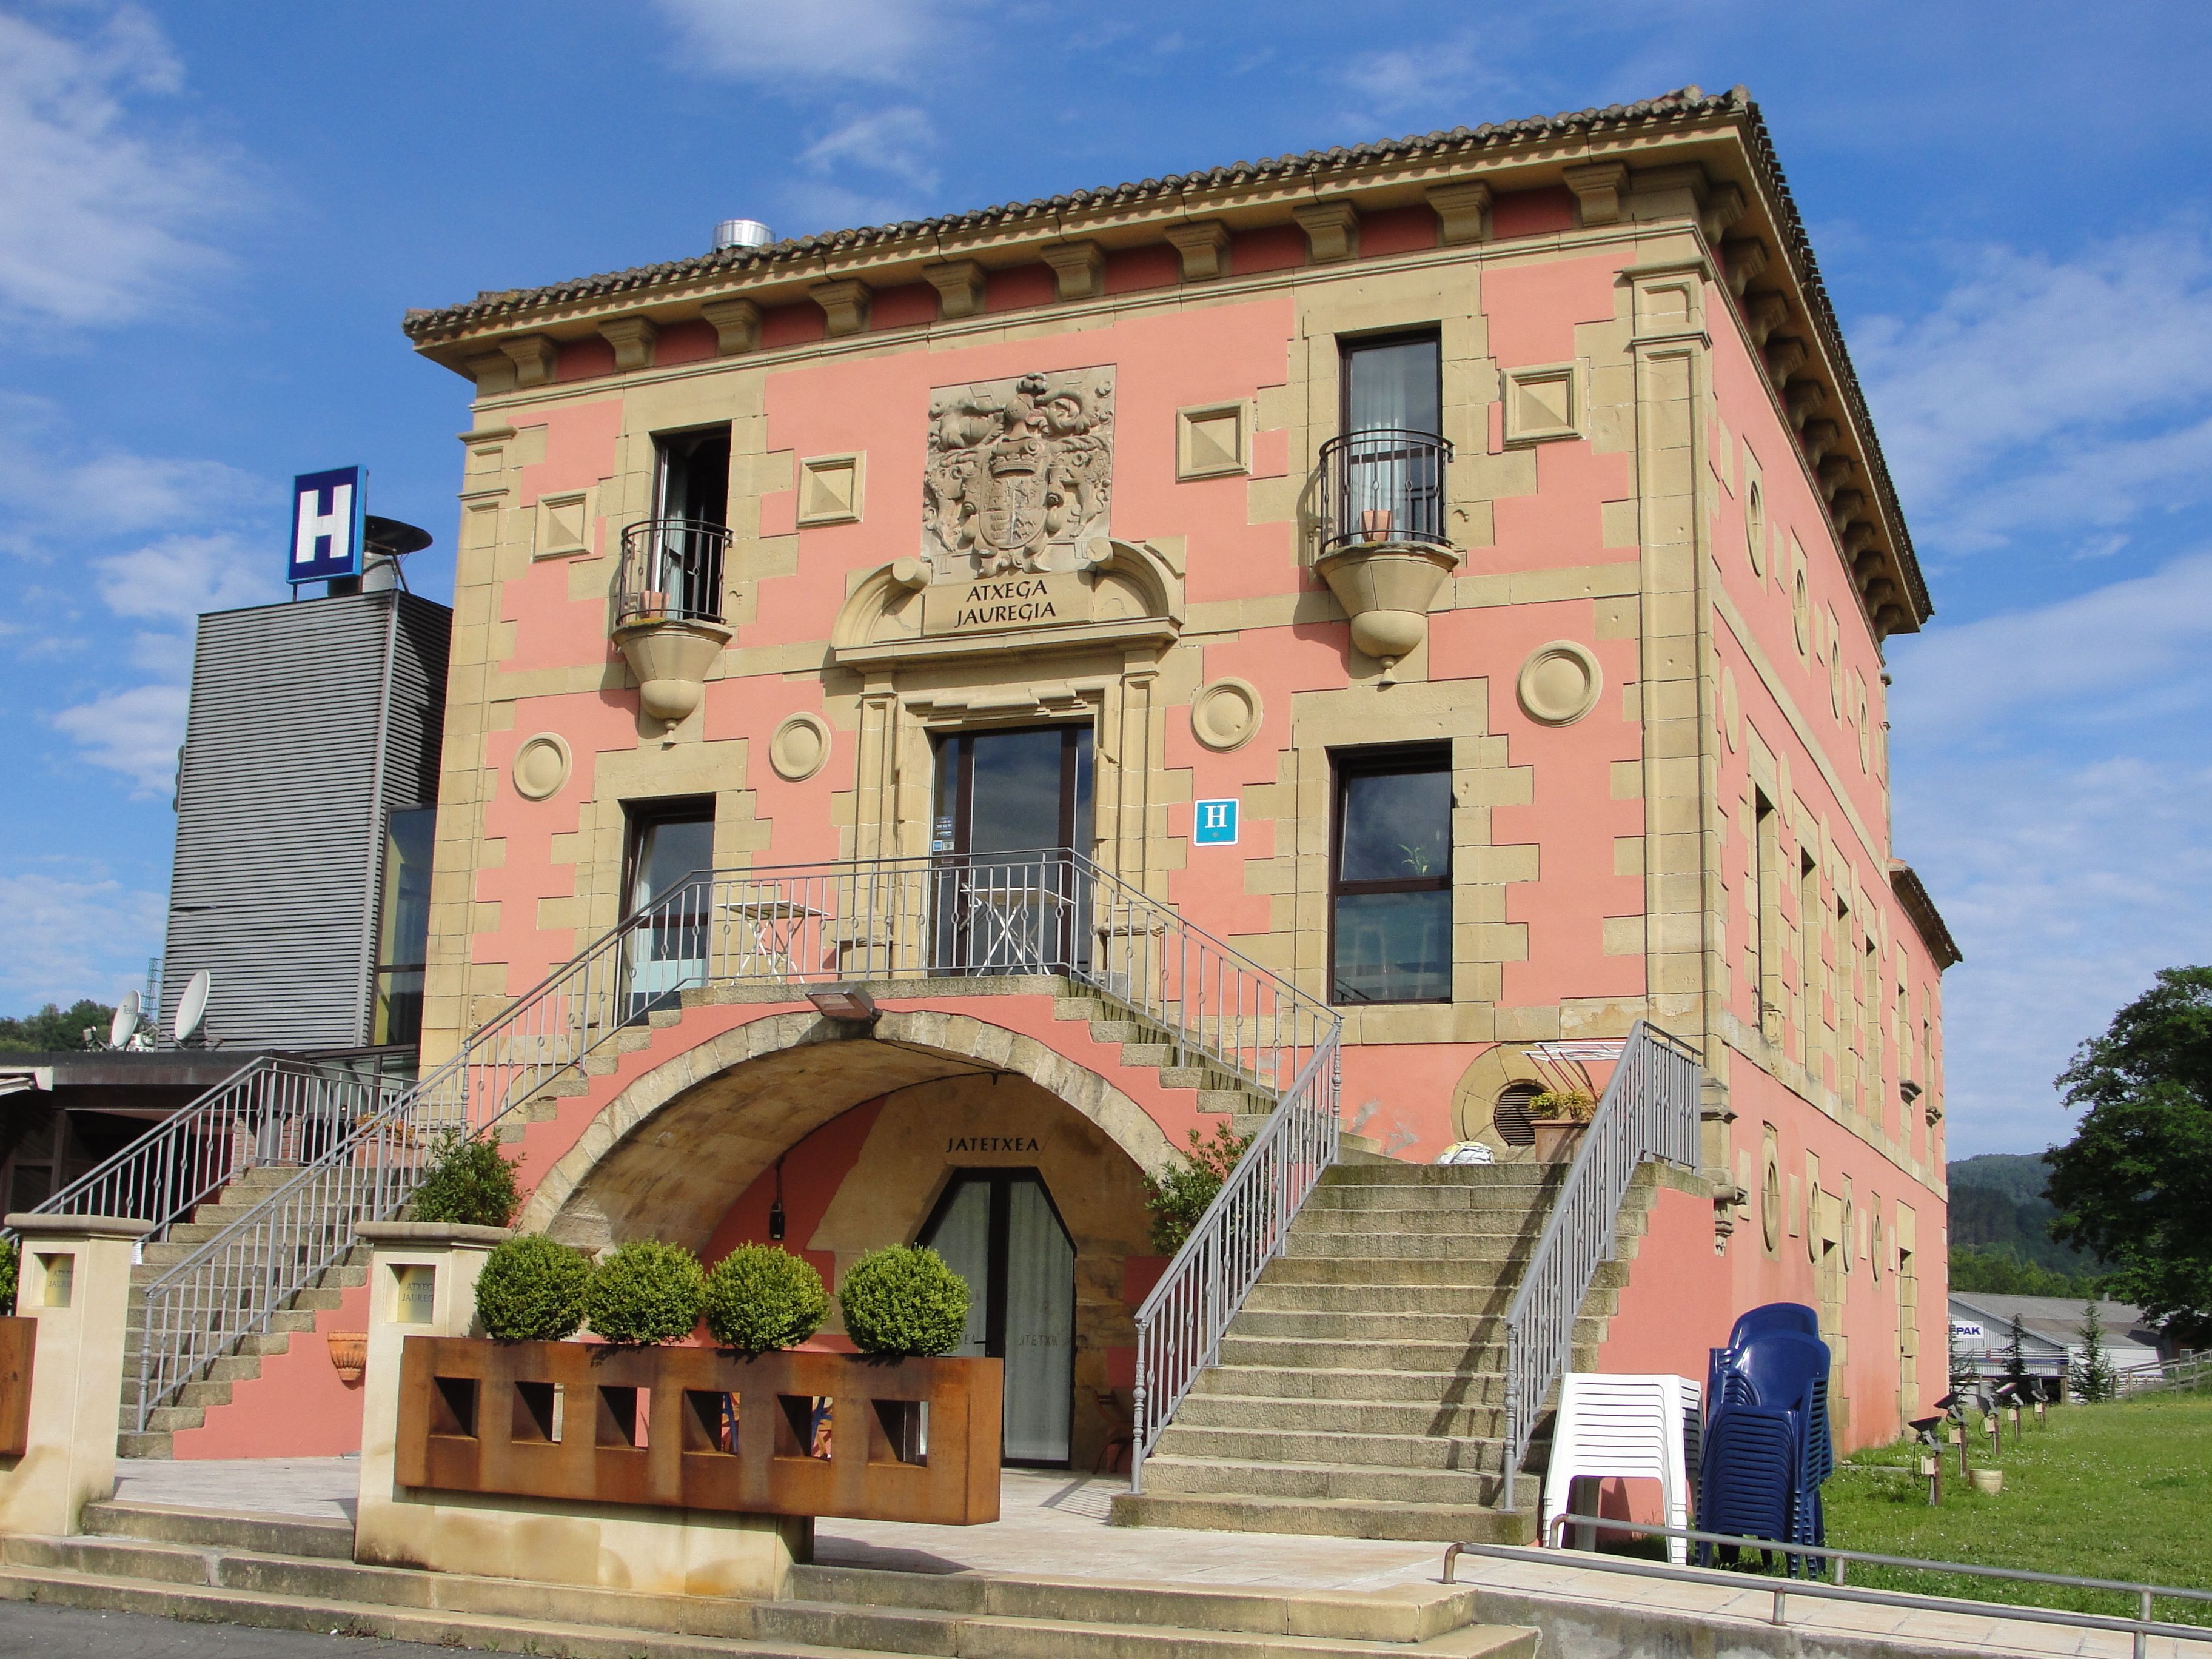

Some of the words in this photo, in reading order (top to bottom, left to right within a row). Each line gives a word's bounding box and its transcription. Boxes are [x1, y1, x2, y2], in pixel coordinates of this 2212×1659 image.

[295, 483, 352, 563] H
[965, 579, 1048, 603] ATXEGA
[954, 602, 1056, 629] JAUREGIA
[1204, 805, 1228, 828] H
[946, 1138, 1039, 1153] JATETXEA
